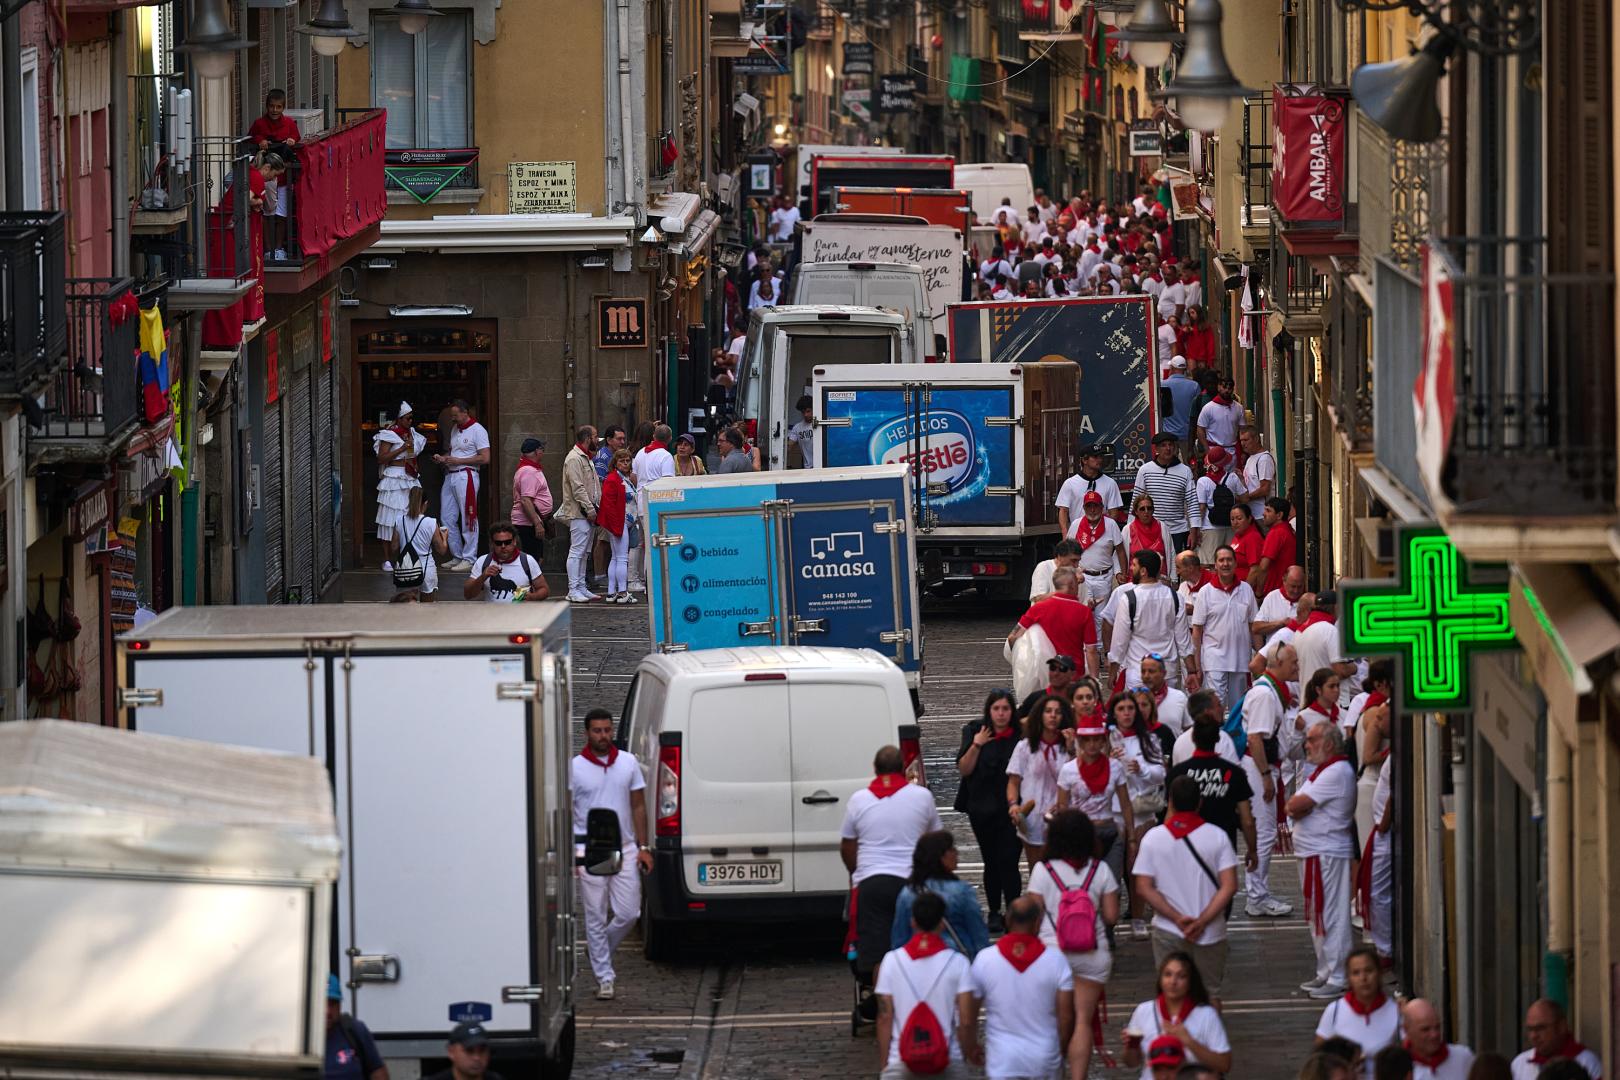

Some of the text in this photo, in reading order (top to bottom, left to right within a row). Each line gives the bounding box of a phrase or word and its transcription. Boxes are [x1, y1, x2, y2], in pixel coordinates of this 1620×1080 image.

[528, 170, 557, 178] TRAVESIA
[1309, 132, 1326, 202] AMBAR
[518, 179, 539, 187] ESPOZ
[551, 179, 567, 187] MINA
[516, 191, 538, 199] ESPOZ
[814, 239, 839, 250] Para
[814, 245, 865, 263] brindar
[881, 243, 917, 256] amor
[907, 247, 953, 263] eterno
[886, 417, 949, 443] HELDOS
[886, 441, 968, 477] estlé
[1116, 454, 1145, 470] rizo
[701, 547, 739, 557] bebidas
[801, 561, 876, 579] canasa
[702, 576, 766, 588] alimentación
[704, 607, 759, 618] congelados
[1187, 768, 1222, 783] PLATA
[1199, 782, 1230, 798] LOMO
[709, 865, 777, 879] 3976 HDY
